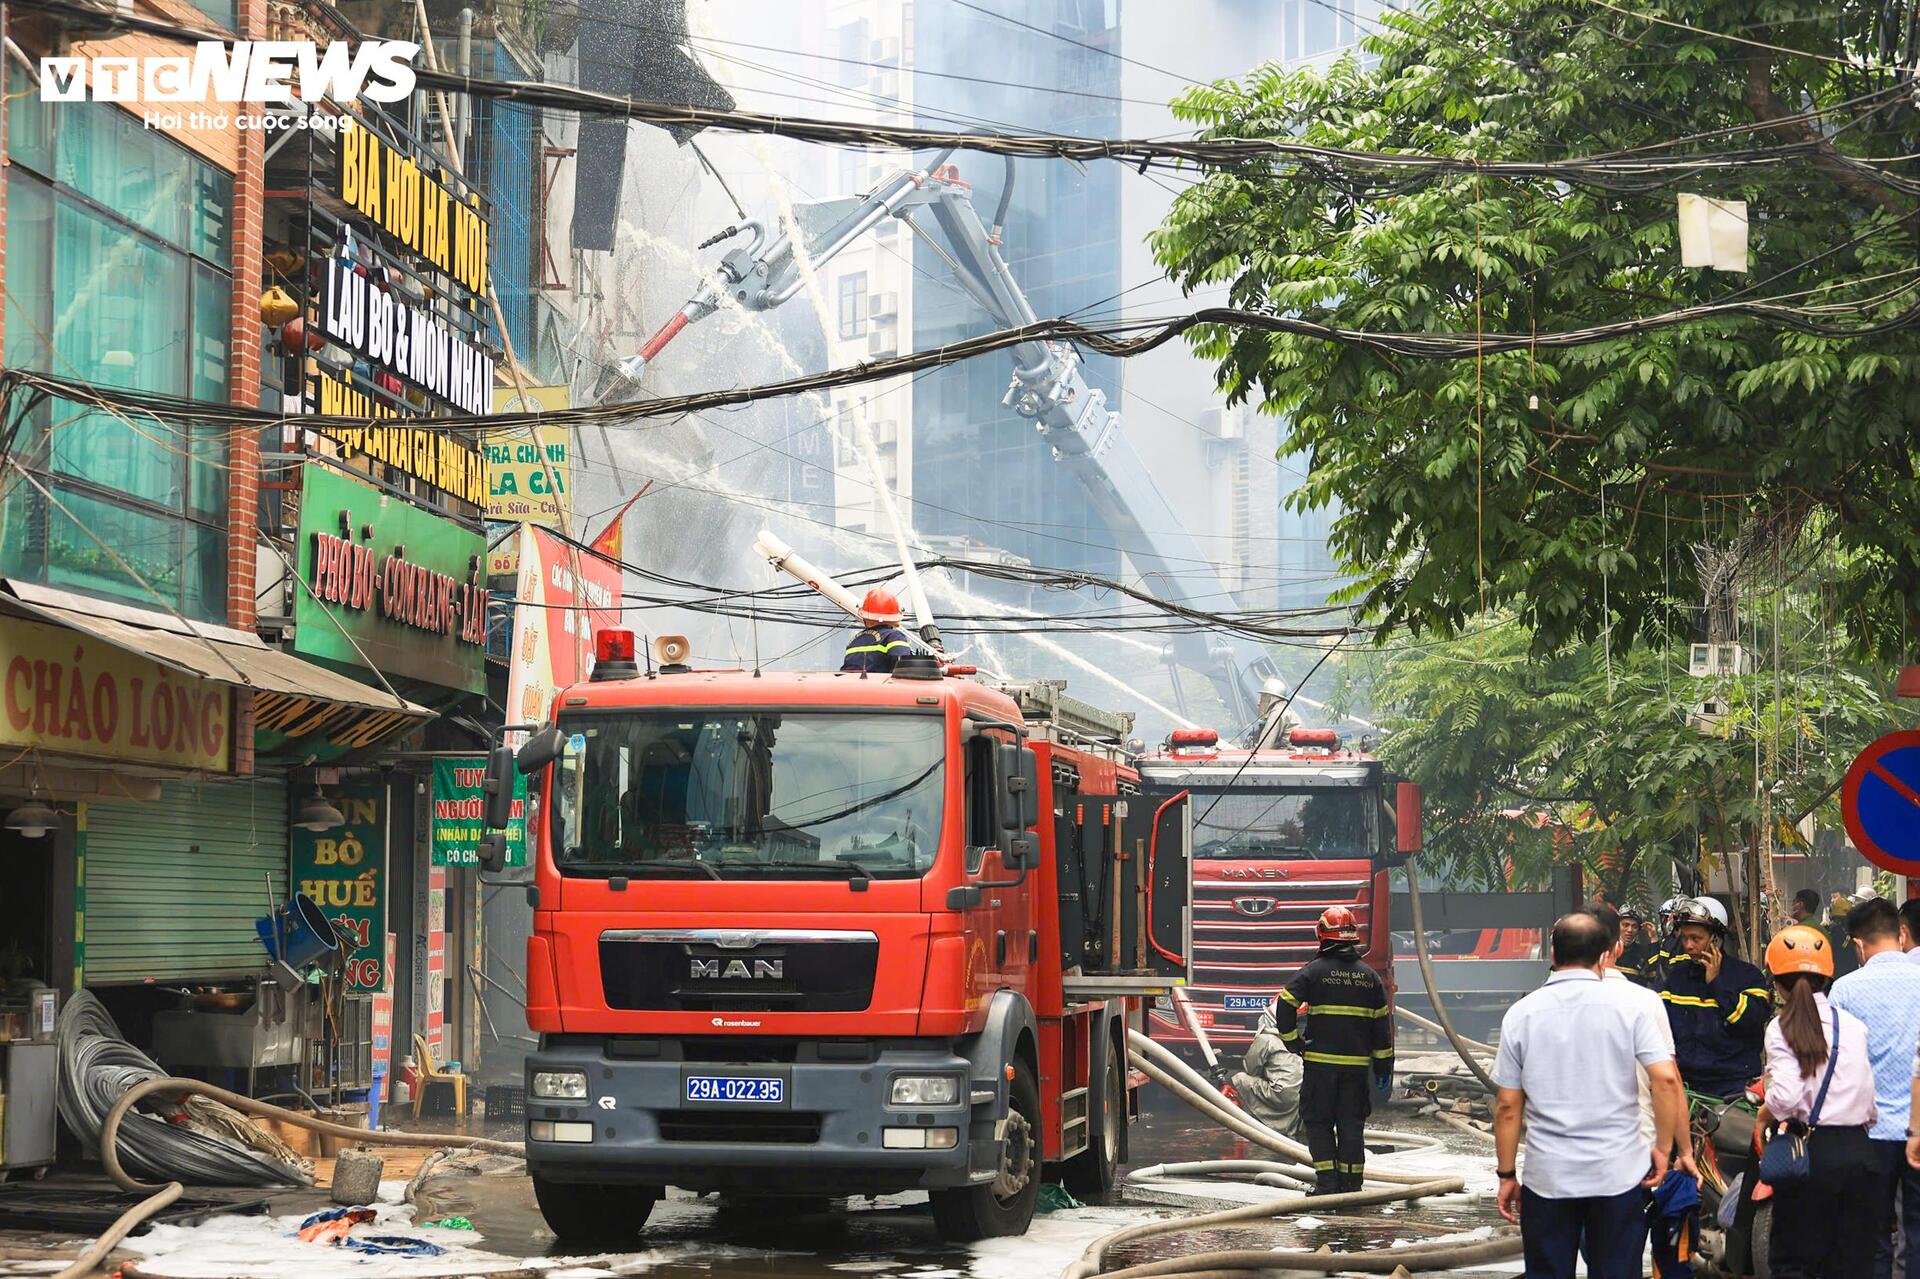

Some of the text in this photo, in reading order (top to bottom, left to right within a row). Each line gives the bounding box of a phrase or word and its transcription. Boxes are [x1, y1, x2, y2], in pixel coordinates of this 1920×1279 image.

[342, 117, 382, 225] BIA
[395, 303, 409, 376] &
[489, 472, 519, 496] LA
[5, 644, 224, 757] CHÁO LÒNG
[454, 766, 488, 788] TUY
[314, 831, 364, 866] BÒ
[463, 849, 479, 863] CH
[1221, 867, 1289, 879] MAXEN
[300, 867, 379, 907] HUẾ
[1402, 938, 1442, 949] MN
[690, 959, 783, 979] MAN
[723, 1019, 762, 1028] rosenbauer
[690, 1079, 780, 1100] 29A-022.95
